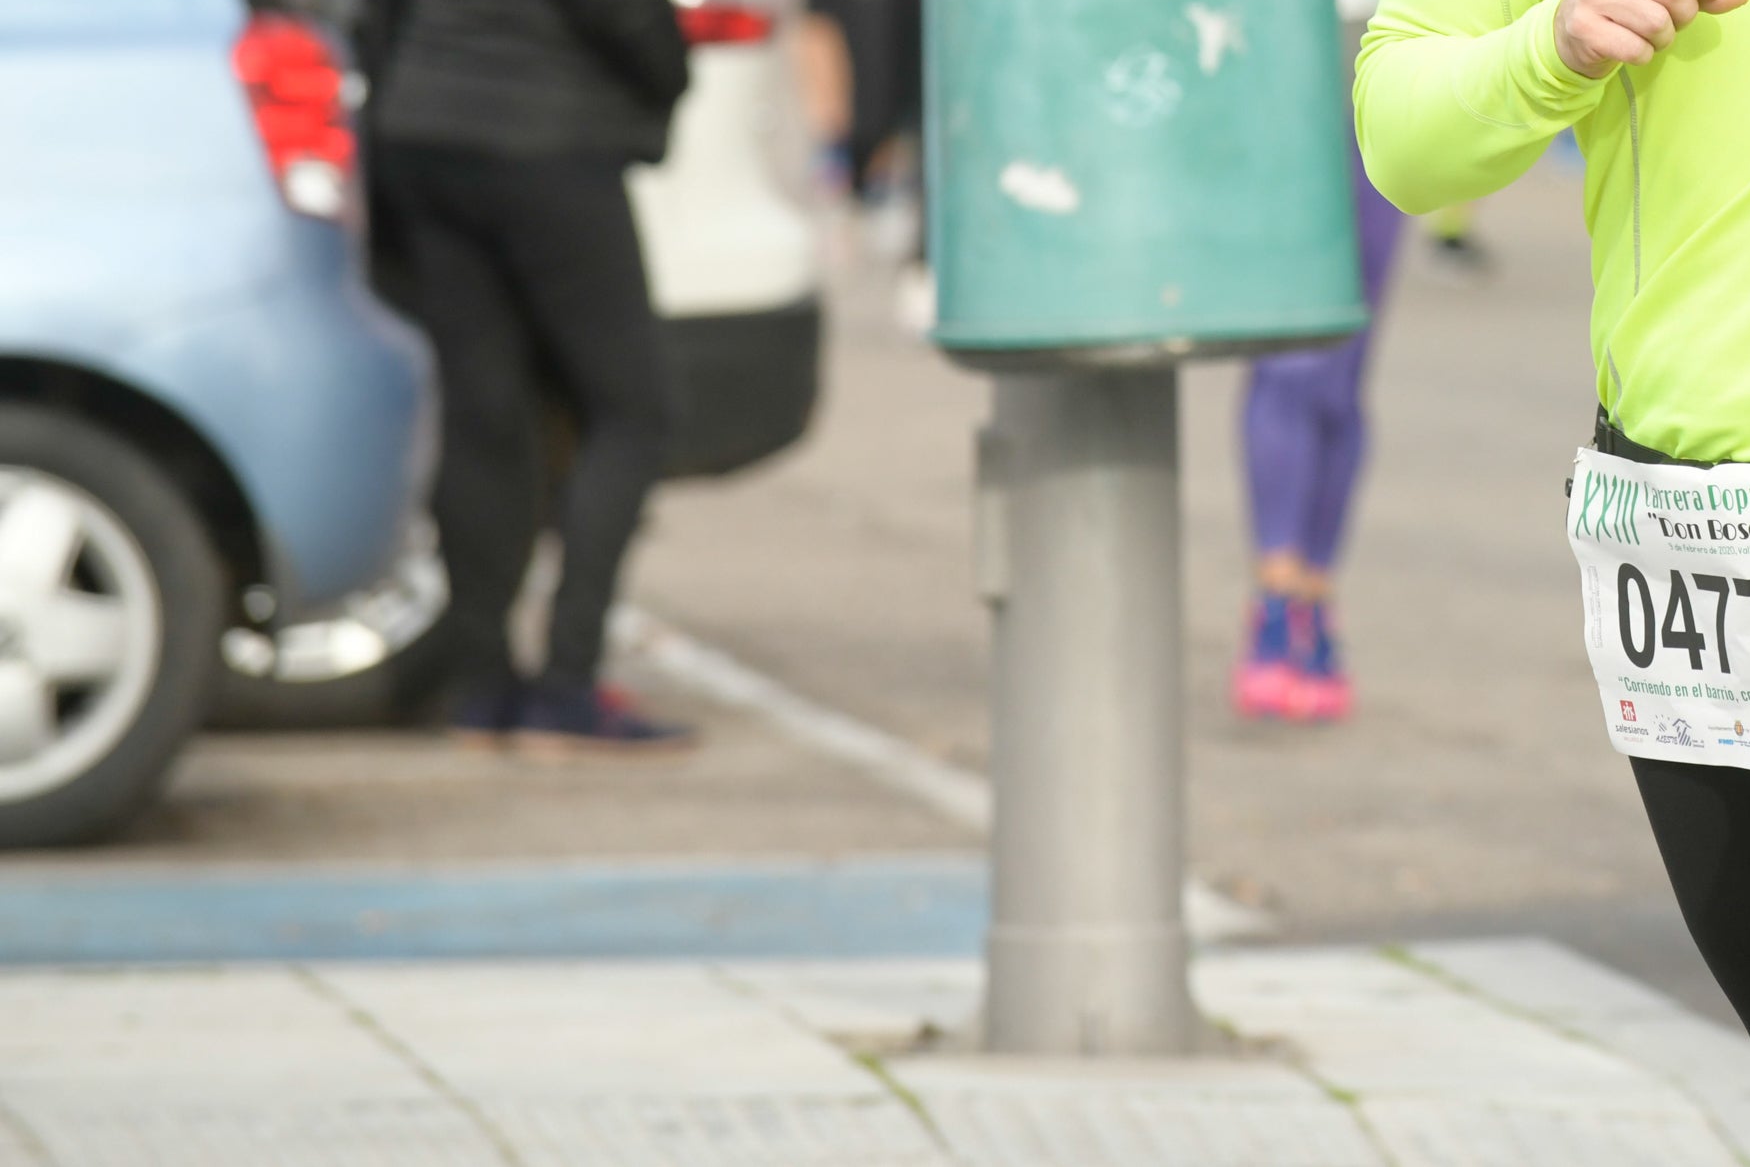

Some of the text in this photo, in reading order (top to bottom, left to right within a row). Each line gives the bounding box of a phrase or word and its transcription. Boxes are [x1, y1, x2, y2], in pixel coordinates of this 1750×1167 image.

[1575, 469, 1640, 545] XXIII
[1643, 481, 1704, 511] Carrera
[1675, 684, 1689, 698] en
[1692, 682, 1702, 698] el
[1705, 683, 1740, 704] barrio,
